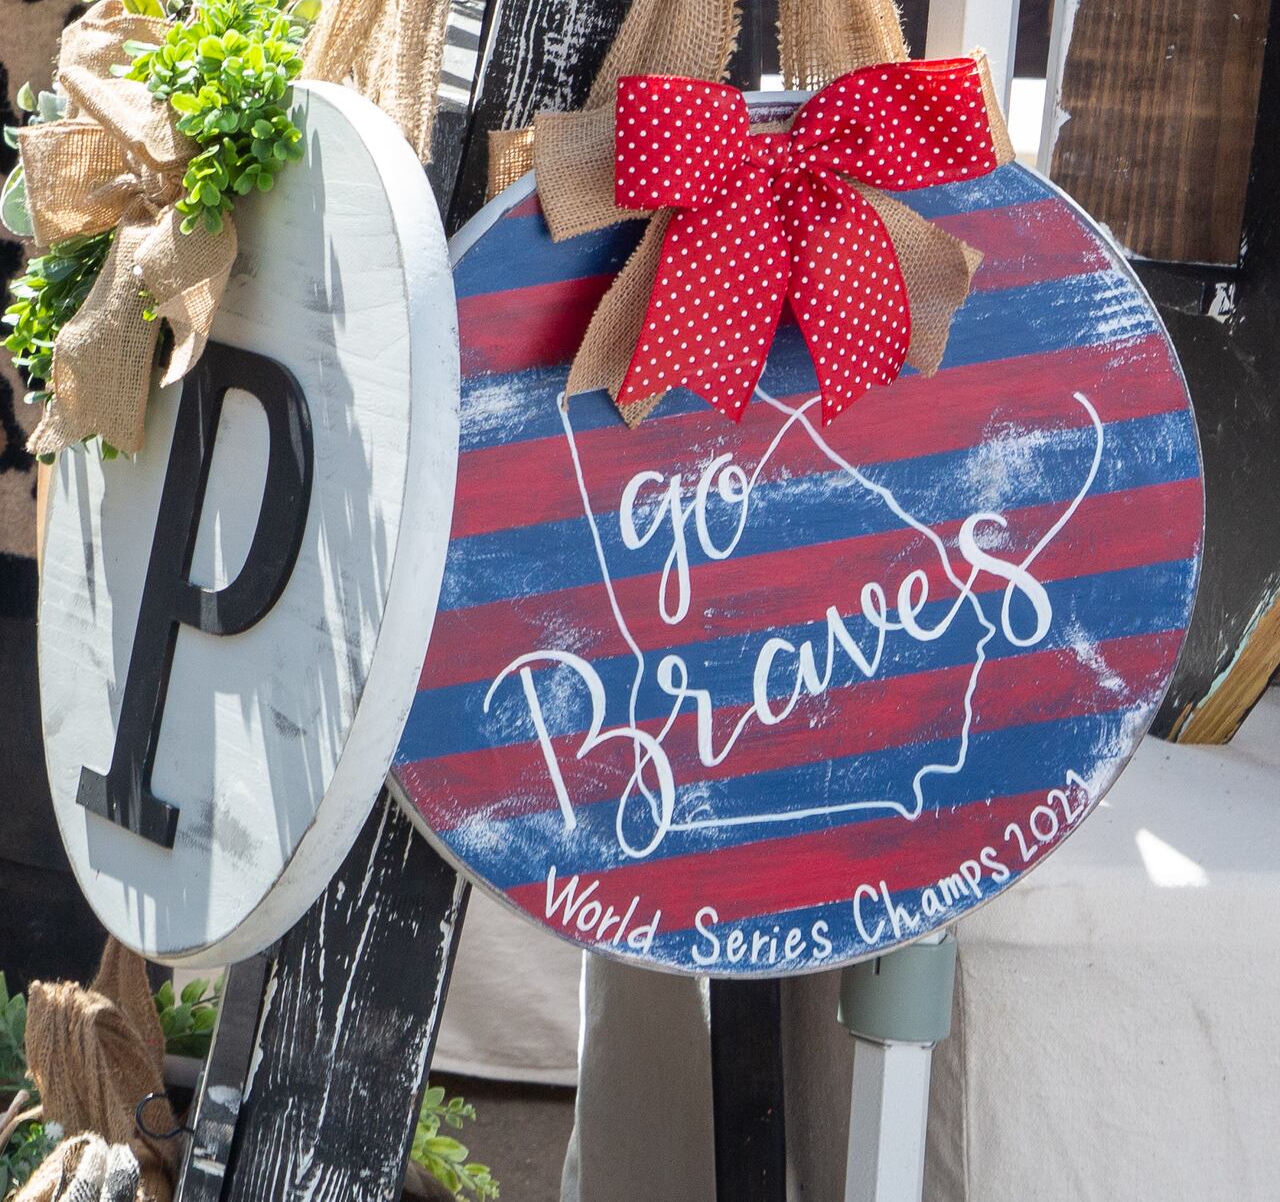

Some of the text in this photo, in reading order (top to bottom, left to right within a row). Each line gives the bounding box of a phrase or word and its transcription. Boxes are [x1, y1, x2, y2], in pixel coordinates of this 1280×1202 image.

[483, 392, 1104, 859] Braves
[545, 768, 1092, 966] World Series Champs 2021
